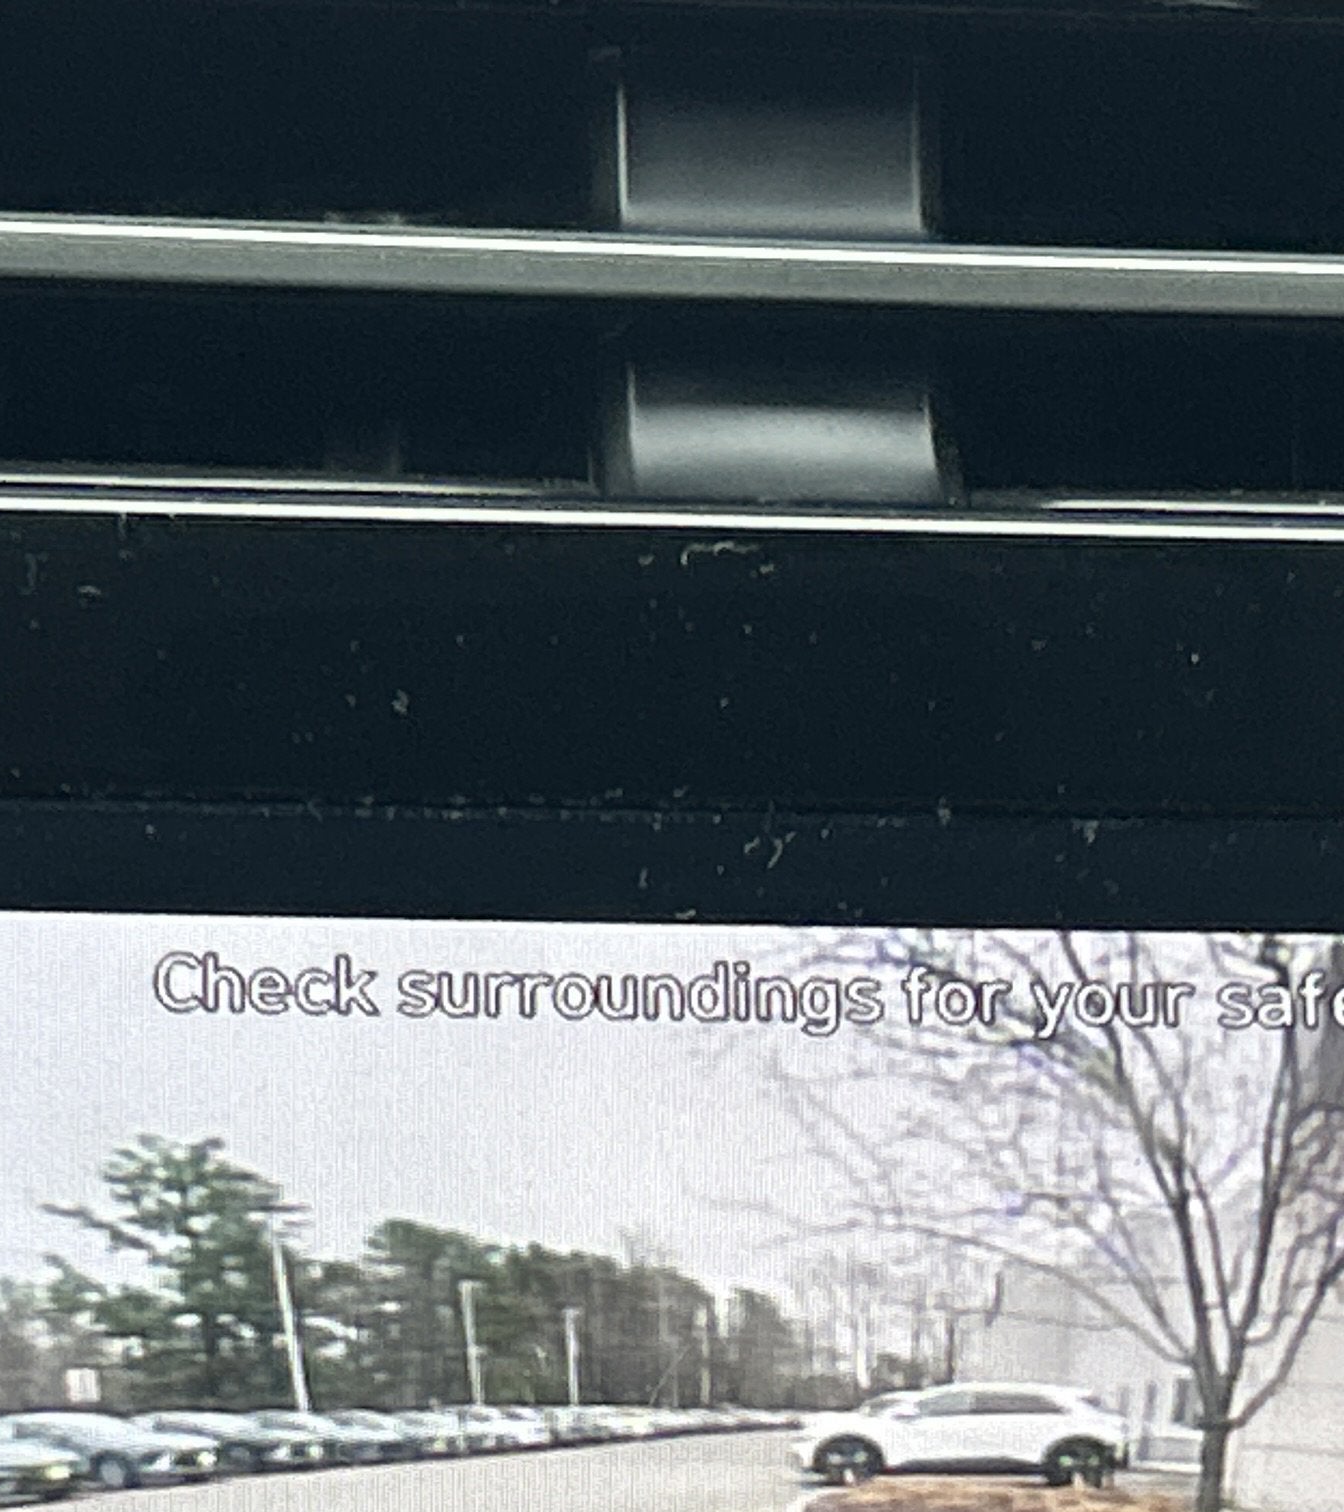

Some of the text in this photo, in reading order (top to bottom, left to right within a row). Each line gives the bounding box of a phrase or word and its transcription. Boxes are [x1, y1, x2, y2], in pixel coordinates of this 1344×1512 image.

[152, 950, 380, 1017] Check
[397, 961, 885, 1036] surroundings
[902, 966, 1010, 1026] for
[1030, 976, 1193, 1039] your
